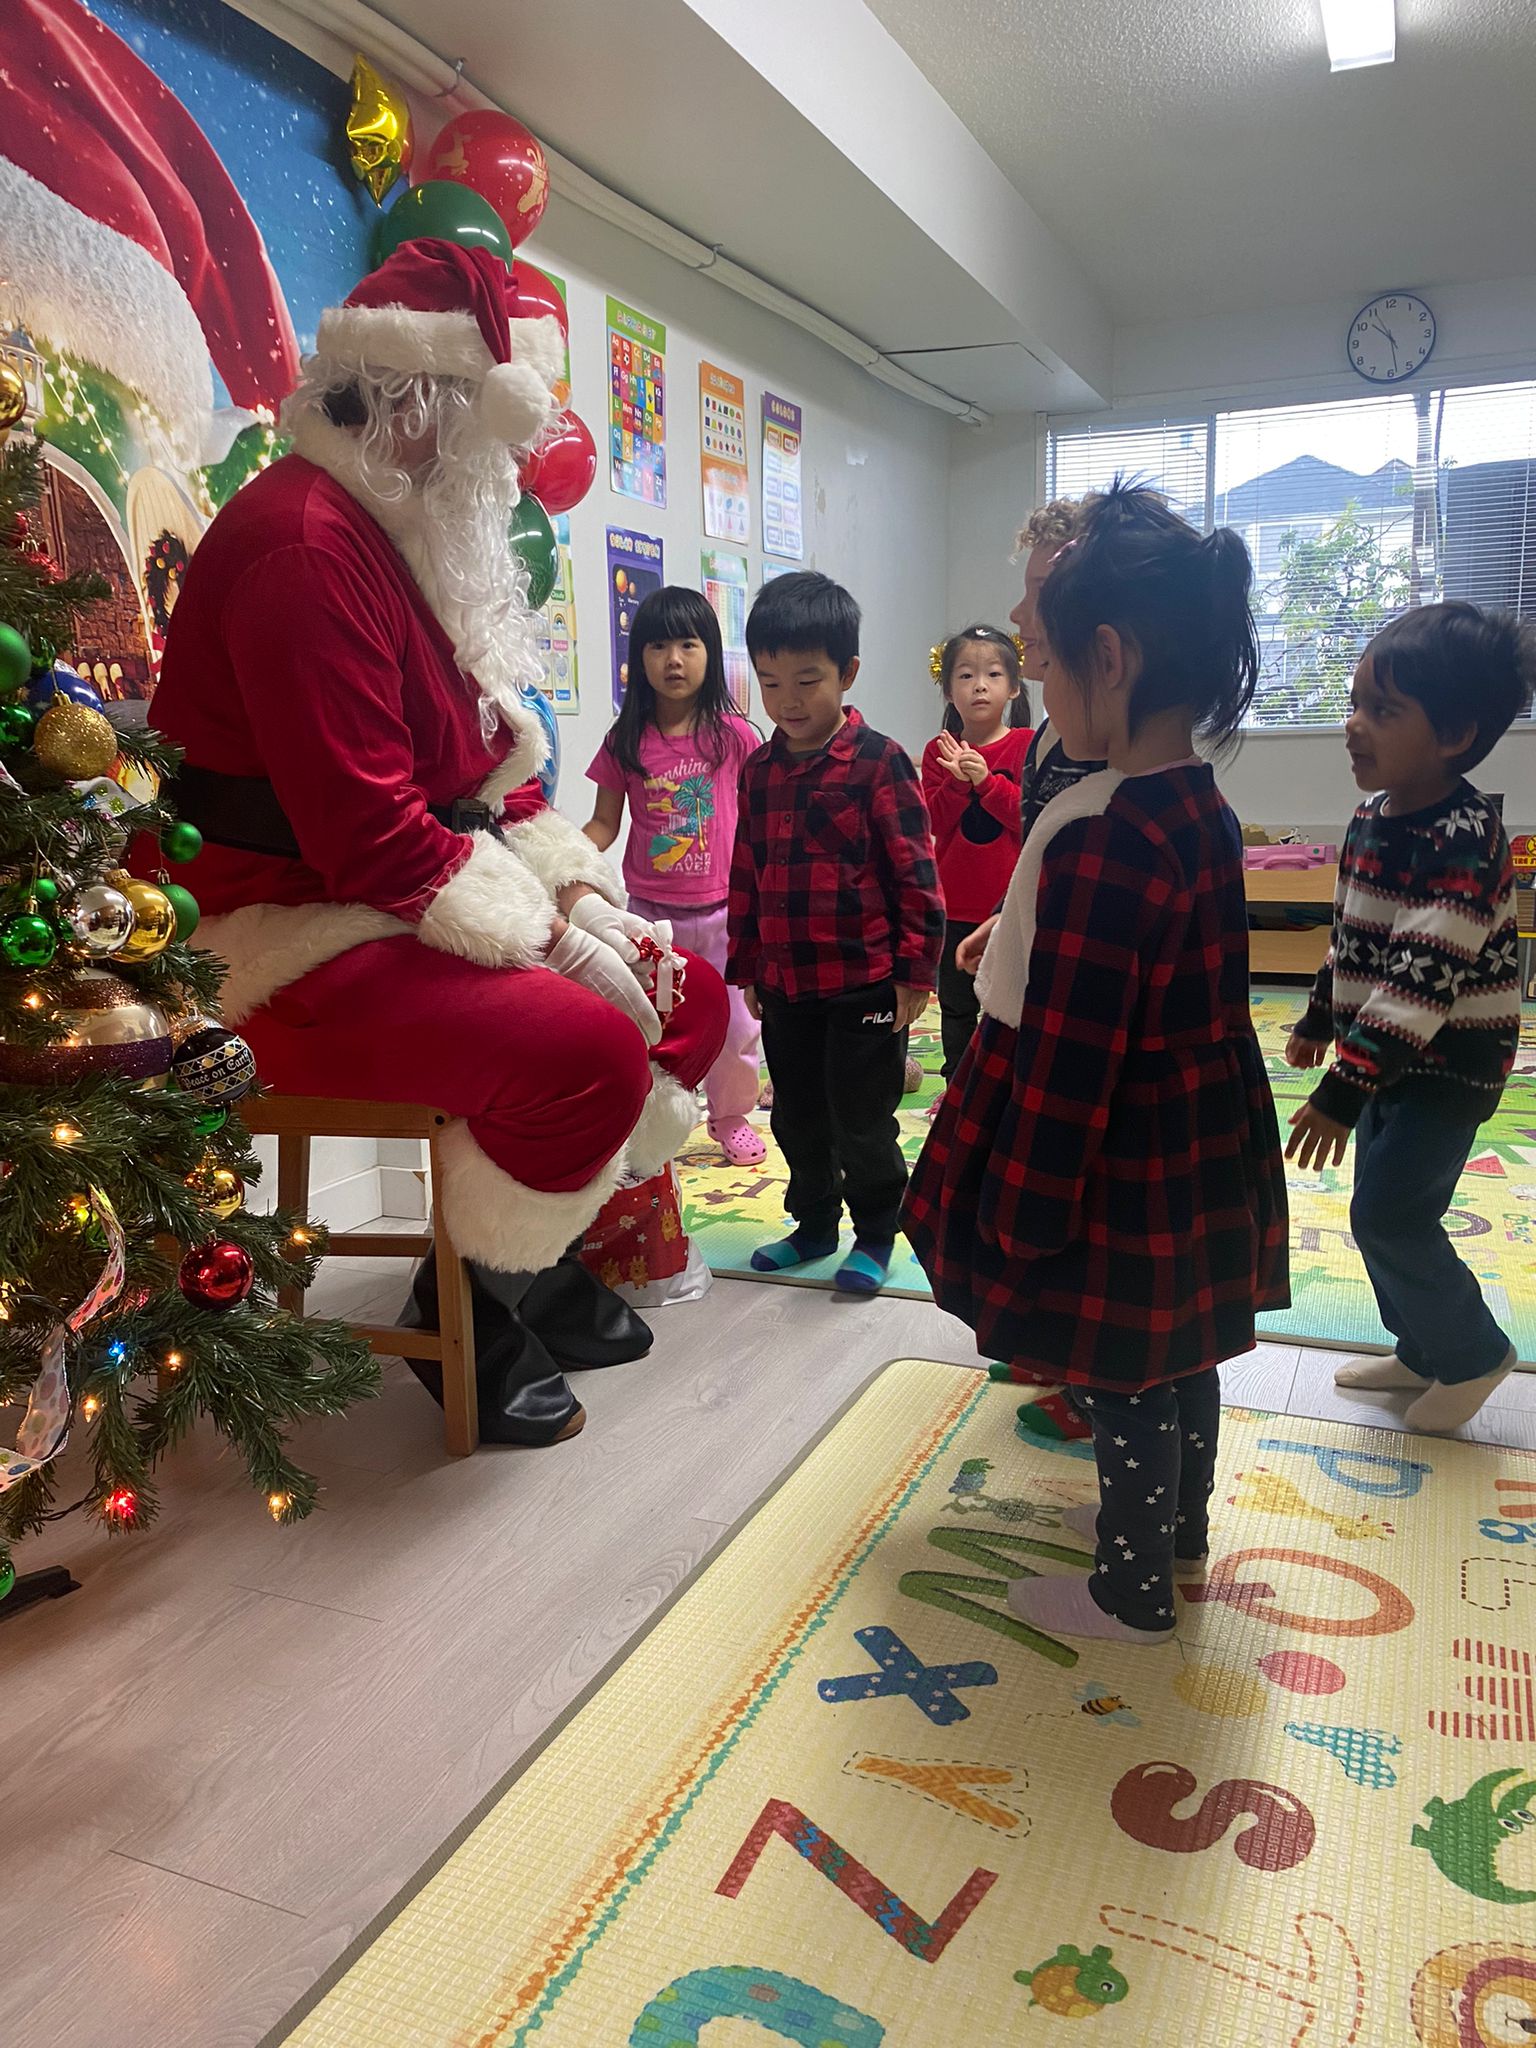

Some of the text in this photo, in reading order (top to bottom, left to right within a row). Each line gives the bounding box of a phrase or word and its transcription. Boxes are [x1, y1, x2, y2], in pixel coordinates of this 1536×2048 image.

[1386, 299, 1397, 309] 12
[1408, 302, 1412, 312] 1
[1368, 308, 1378, 318] 11
[1419, 312, 1427, 322] 2
[1357, 322, 1368, 332] 10
[1424, 329, 1432, 338] 3
[1352, 340, 1360, 349] 9
[623, 340, 630, 352] Bb
[643, 352, 650, 362] Dd
[1419, 346, 1426, 356] 4
[1356, 356, 1364, 366] 8
[1406, 361, 1413, 370] 5
[1369, 366, 1377, 376] 7
[1387, 369, 1394, 378] 6
[634, 408, 642, 419] Nn
[684, 852, 711, 862] AND
[862, 1010, 895, 1024] FILA
[182, 1047, 251, 1090] Peace on Earth
[816, 1625, 998, 1726] X
[851, 1754, 1023, 1833] Y
[1110, 1761, 1316, 1872] S
[714, 1797, 999, 1964] Z
